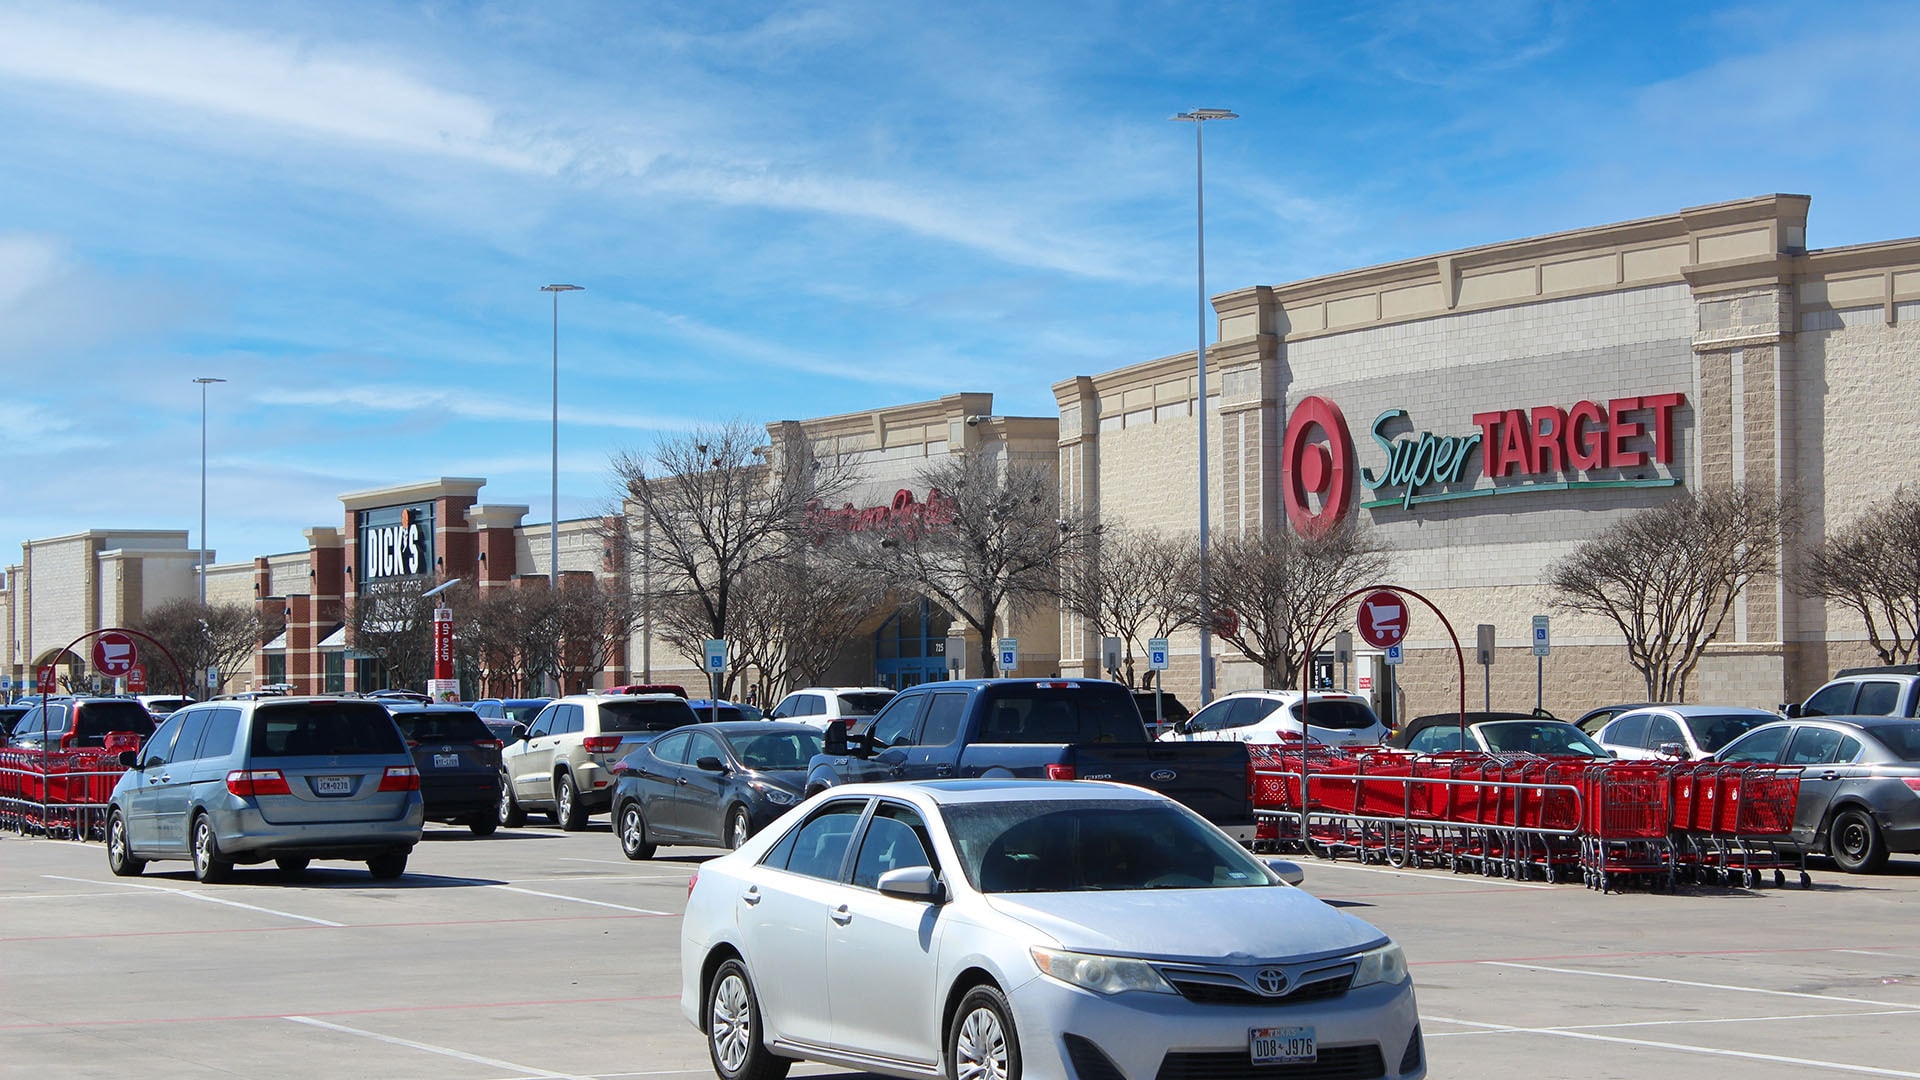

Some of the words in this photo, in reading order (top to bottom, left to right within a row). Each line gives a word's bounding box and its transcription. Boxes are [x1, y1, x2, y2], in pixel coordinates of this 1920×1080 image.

[368, 523, 419, 578] DICK'S
[442, 622, 450, 635] up
[441, 638, 450, 661] drive
